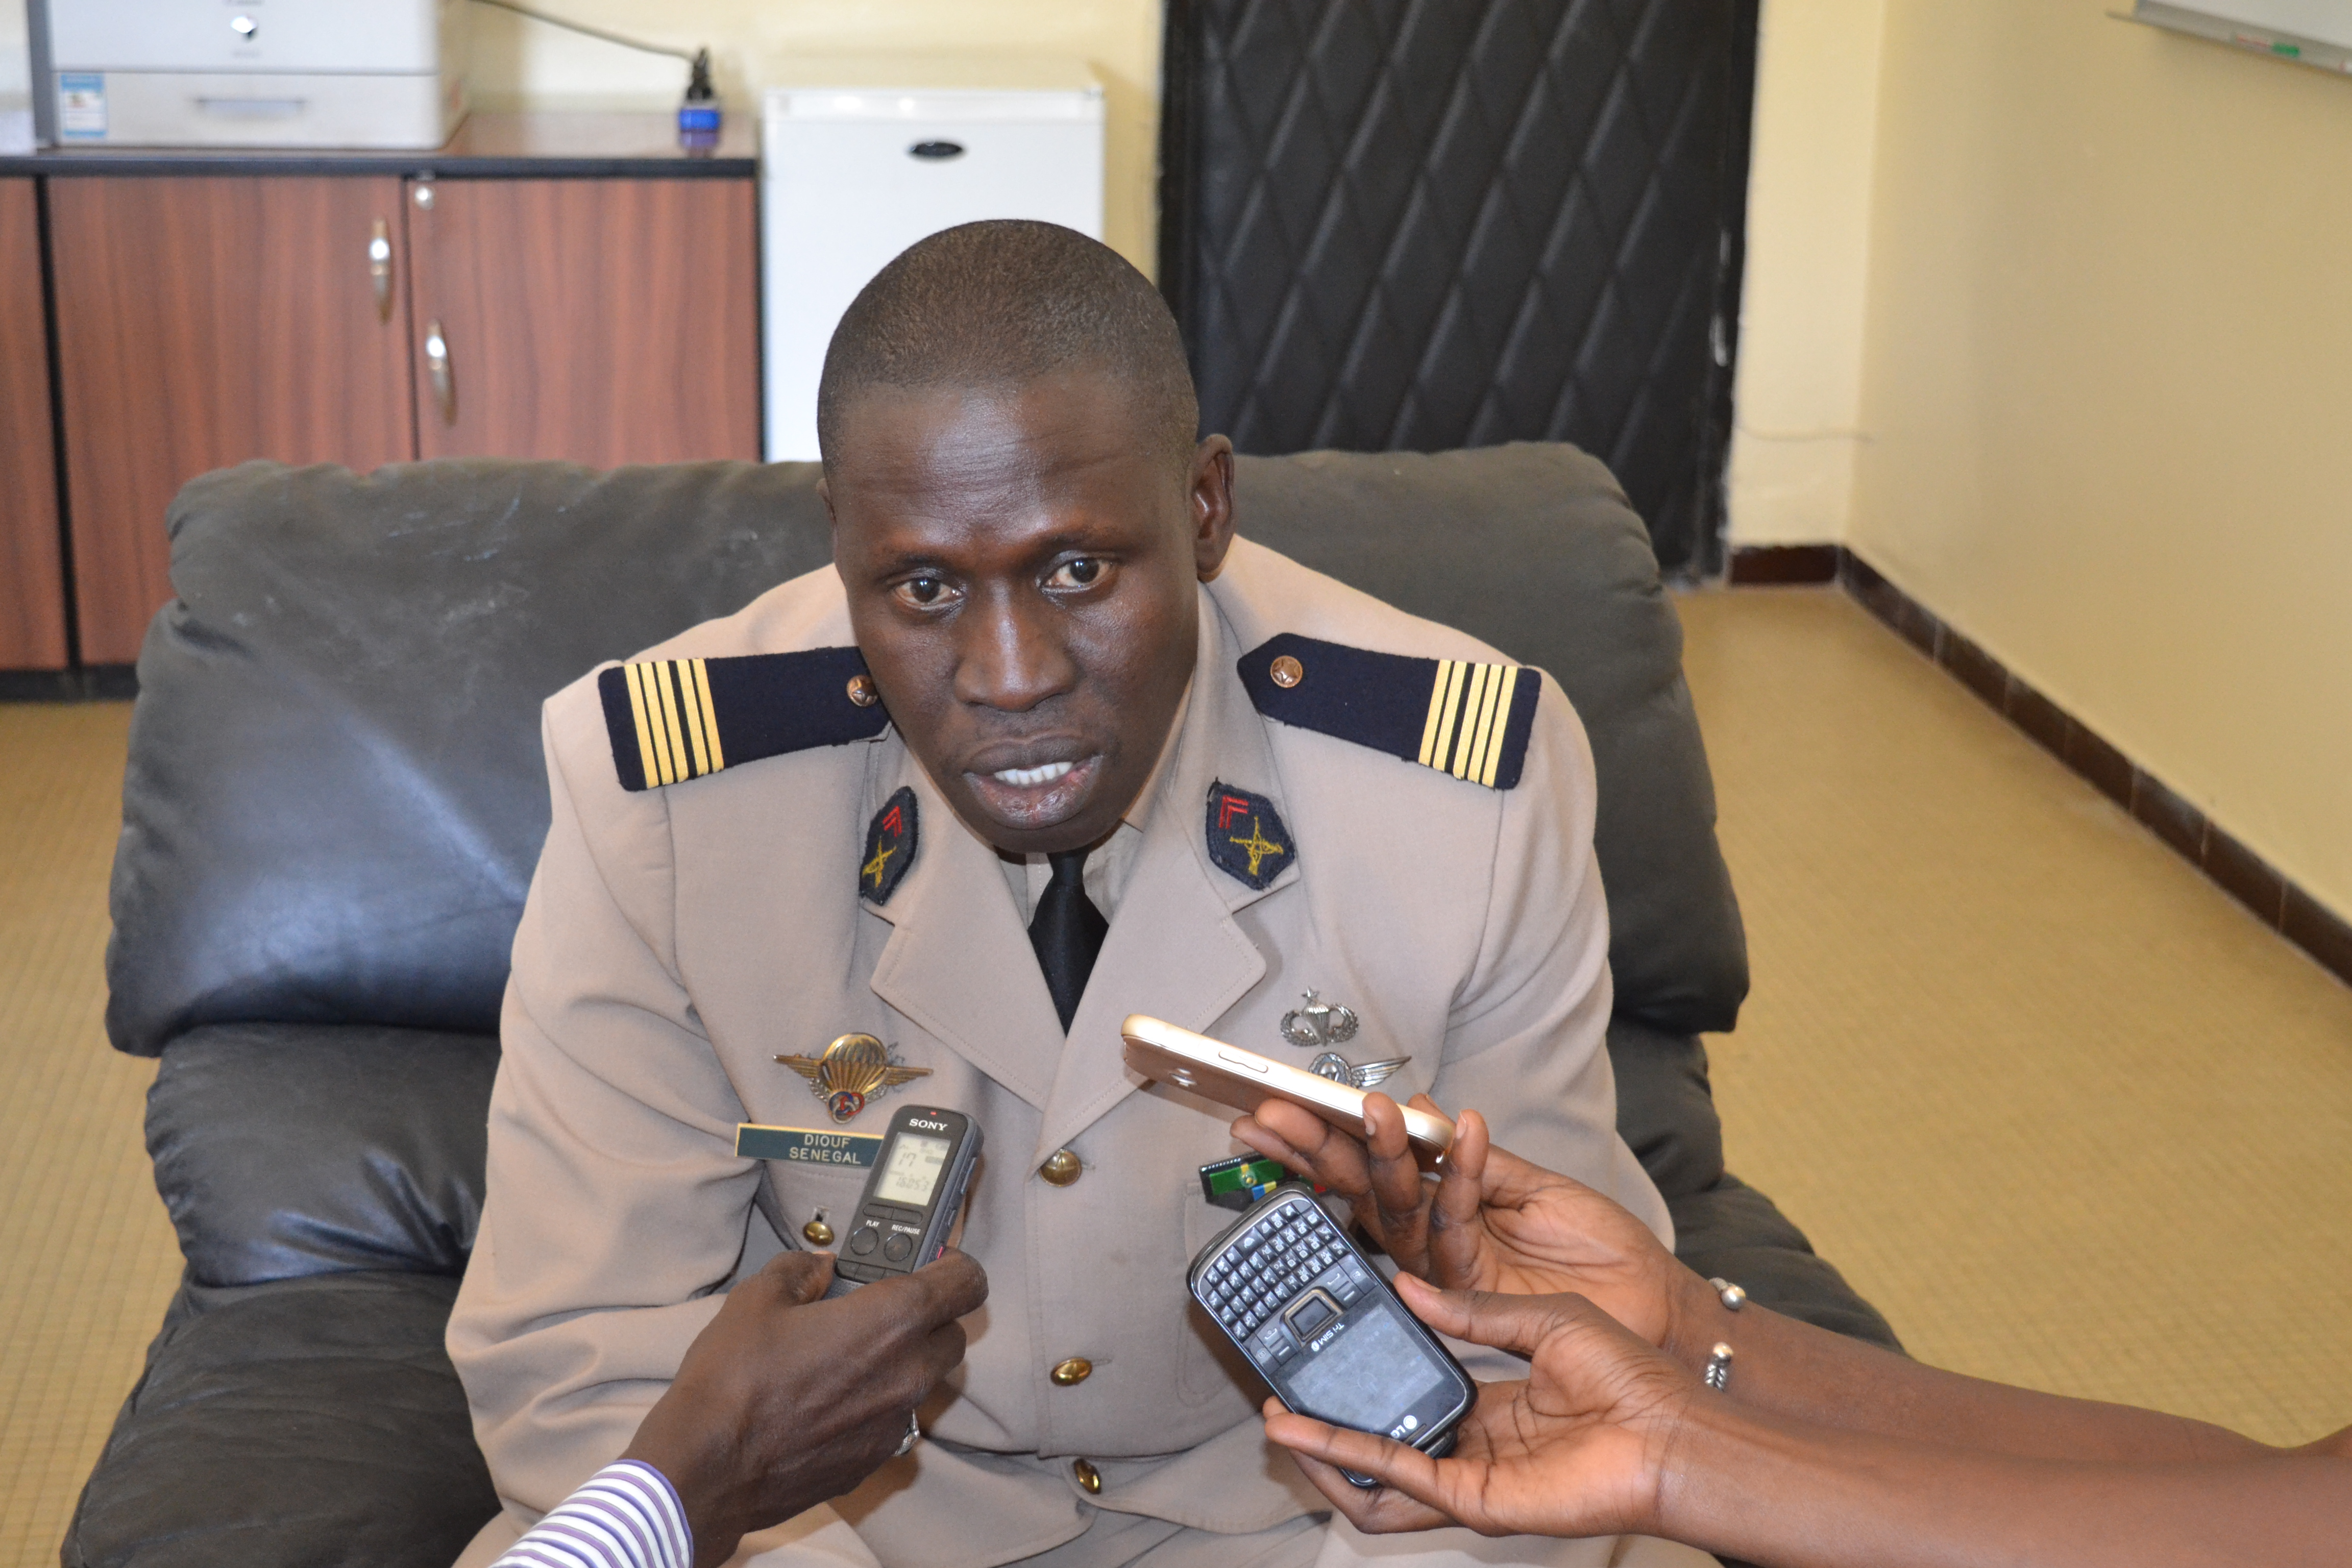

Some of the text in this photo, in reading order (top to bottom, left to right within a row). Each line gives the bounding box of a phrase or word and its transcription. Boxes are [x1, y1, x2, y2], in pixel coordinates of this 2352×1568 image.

[909, 1118, 948, 1131] SONY
[804, 1134, 851, 1148] DIOUF
[789, 1147, 861, 1165] SENEGAL
[866, 1219, 880, 1228] PLAY
[891, 1224, 921, 1235] REC/PAUSE
[1332, 1322, 1344, 1333] Tri
[1317, 1329, 1334, 1345] SIM
[1389, 1424, 1406, 1438] LG
